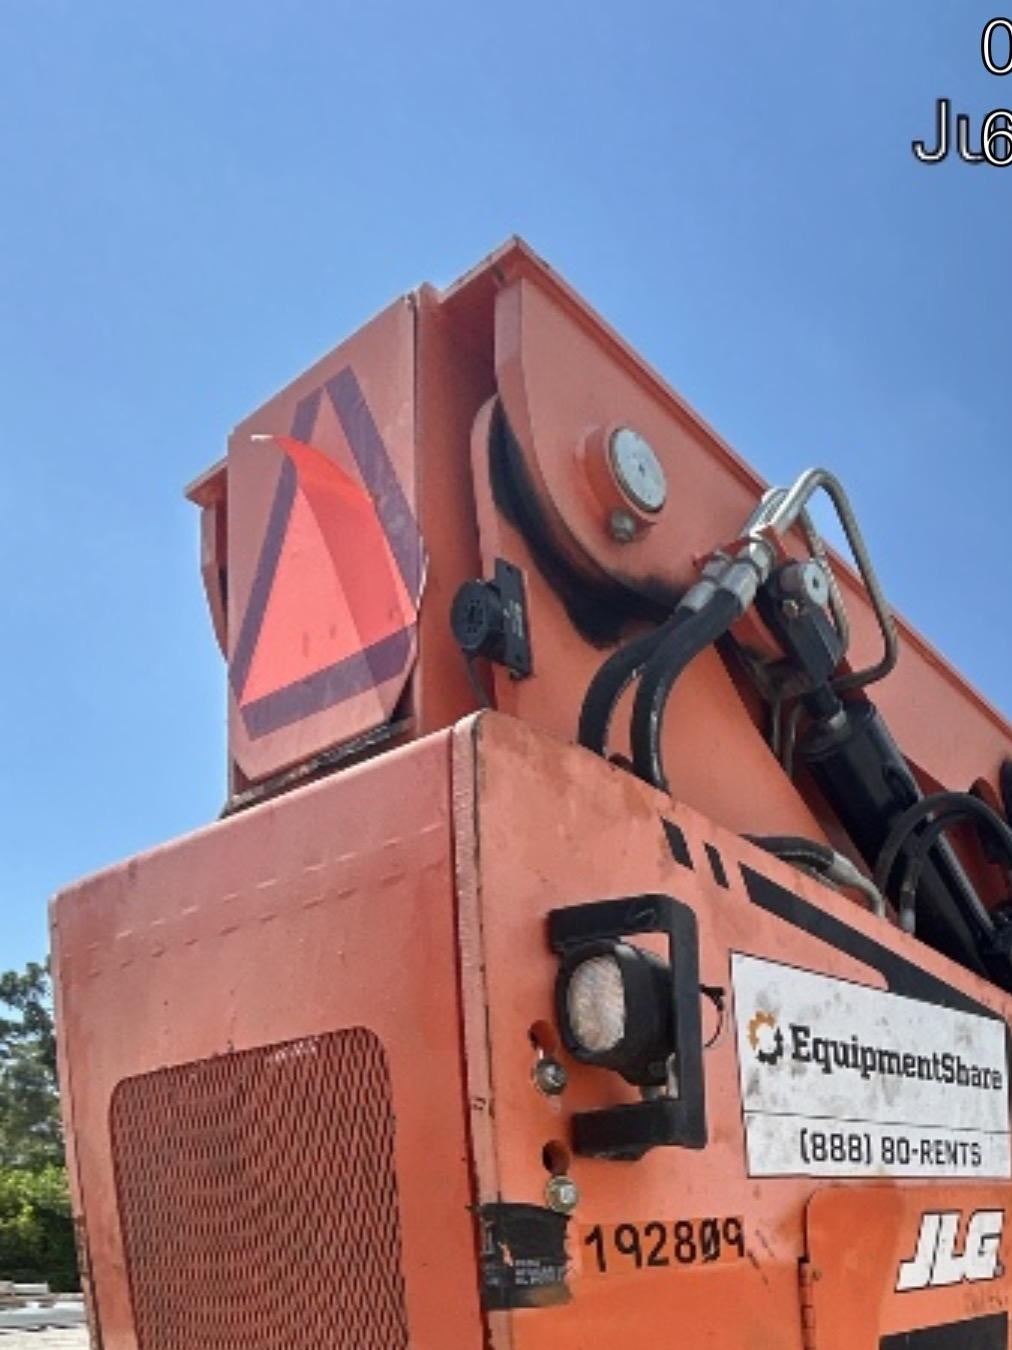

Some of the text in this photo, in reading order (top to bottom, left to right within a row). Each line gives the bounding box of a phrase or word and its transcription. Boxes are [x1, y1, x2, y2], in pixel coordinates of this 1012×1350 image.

[789, 1023, 1003, 1090] EquipmentShare
[800, 1128, 983, 1167] (888) 80-RENTS
[894, 1208, 1005, 1294] JLG
